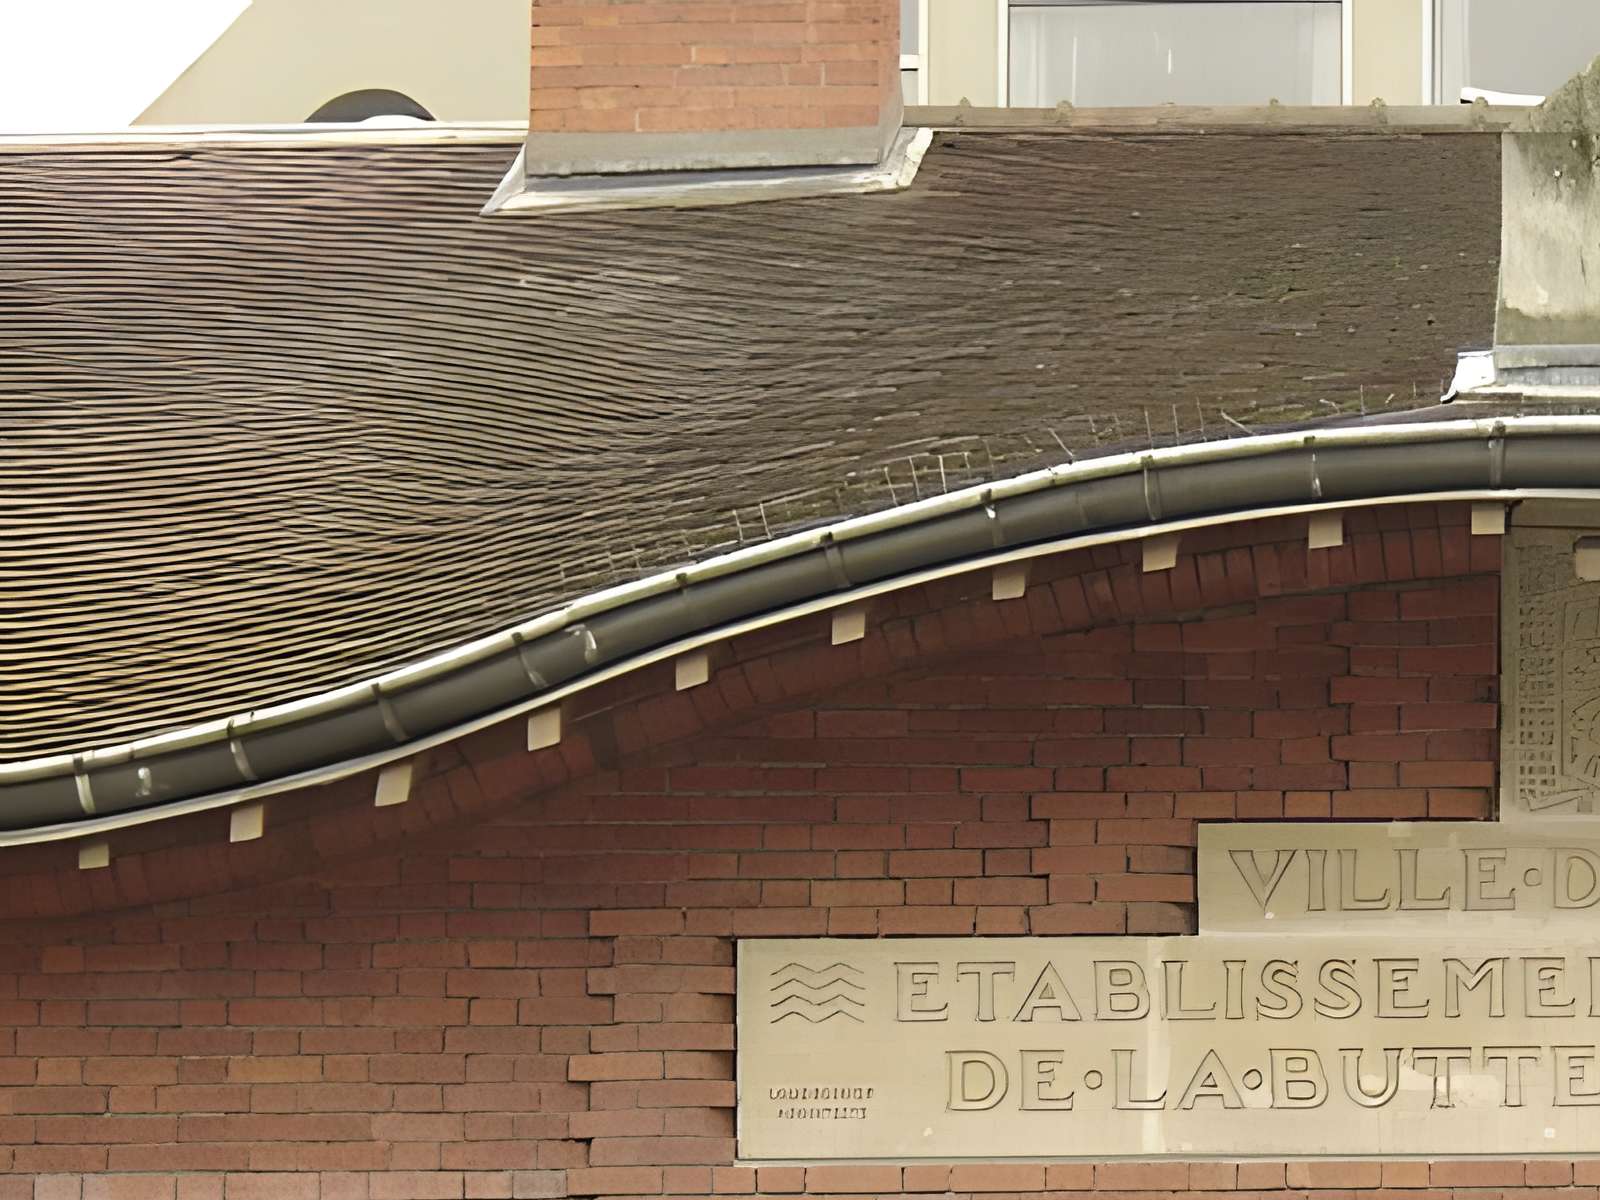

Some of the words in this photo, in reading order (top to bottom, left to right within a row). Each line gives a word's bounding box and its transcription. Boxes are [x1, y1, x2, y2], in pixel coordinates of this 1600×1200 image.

[1228, 848, 1516, 912] VILLE
[945, 1048, 1073, 1112] DE
[1111, 1048, 1244, 1110] LA
